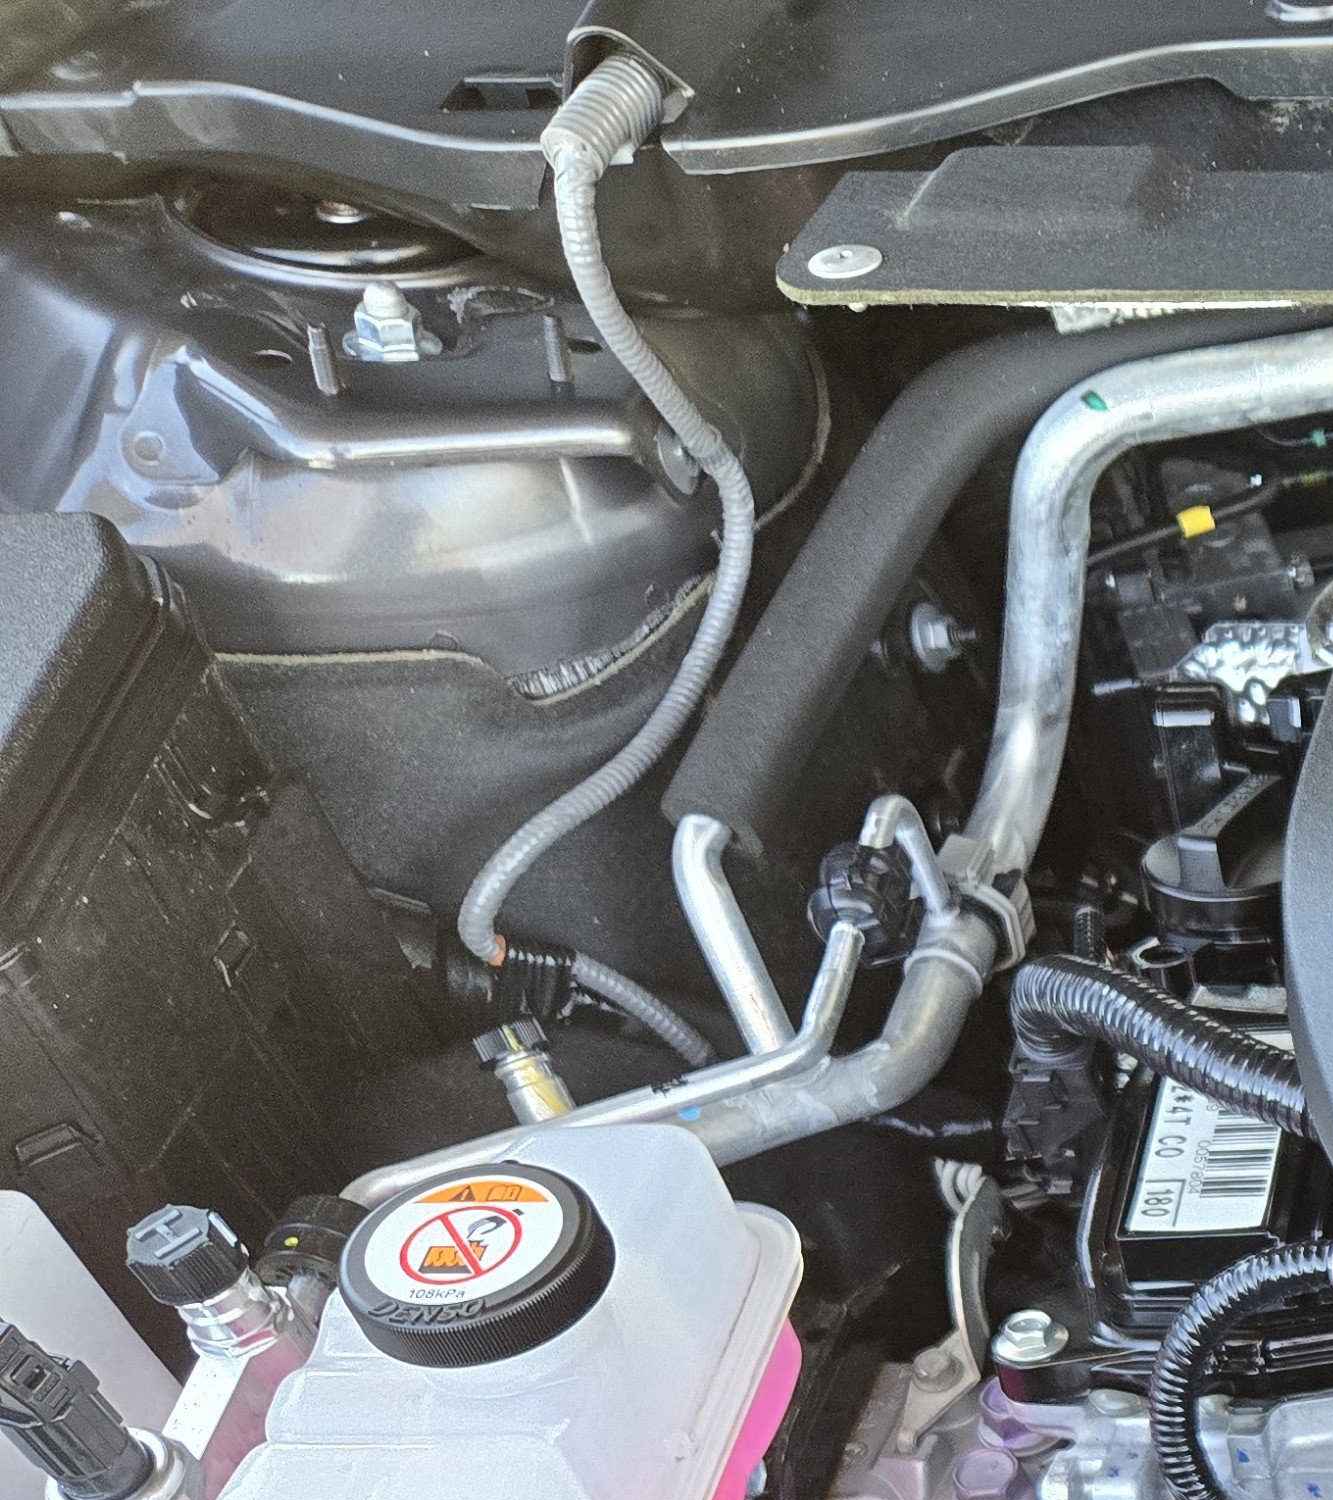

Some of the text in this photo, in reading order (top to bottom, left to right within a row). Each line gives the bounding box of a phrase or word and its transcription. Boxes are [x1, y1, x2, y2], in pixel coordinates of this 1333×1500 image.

[1140, 1188, 1175, 1217] 180
[408, 1288, 466, 1300] 108kPa
[368, 1298, 487, 1326] DENSO
